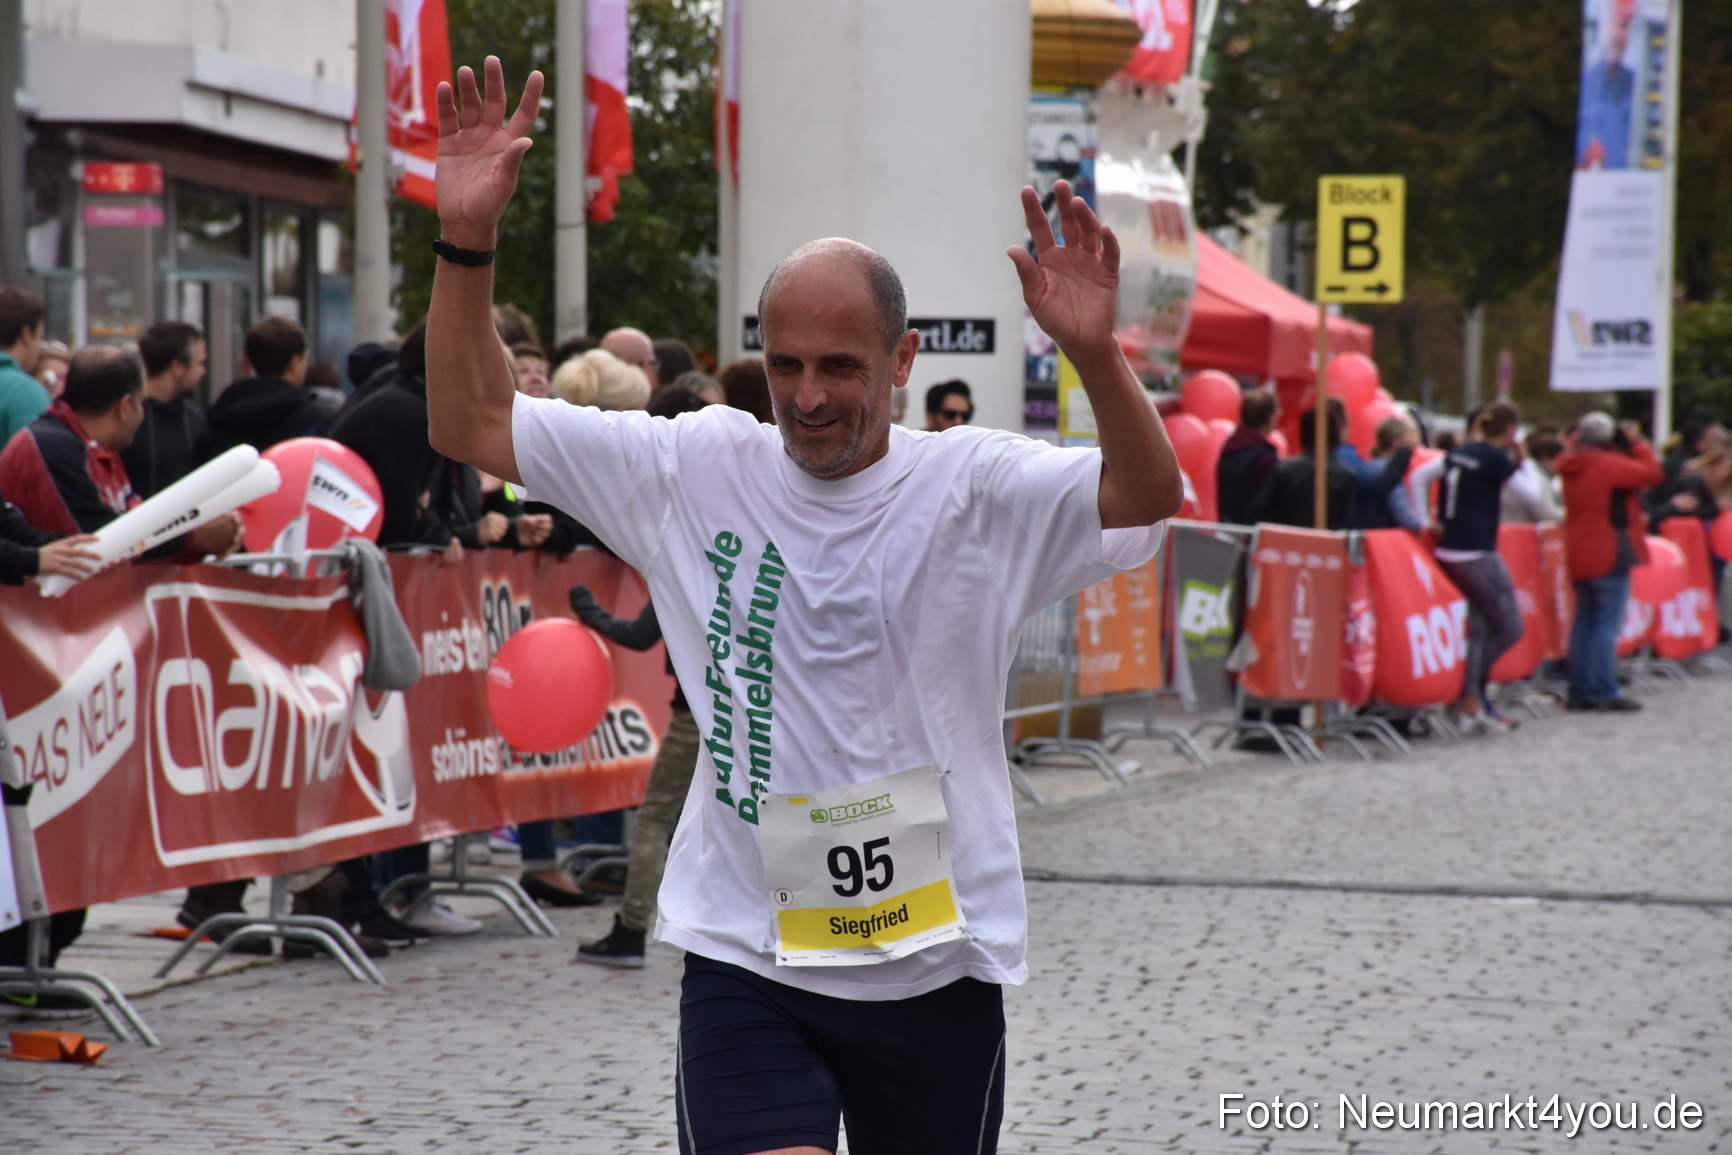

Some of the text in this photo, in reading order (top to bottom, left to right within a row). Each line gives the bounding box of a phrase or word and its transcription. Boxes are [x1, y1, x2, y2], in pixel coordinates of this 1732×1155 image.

[1329, 183, 1392, 205] Block
[1342, 217, 1380, 271] B
[78, 660, 127, 769] NEUE
[829, 793, 894, 822] BOCK
[827, 836, 894, 897] 95
[780, 892, 787, 902] D
[829, 903, 909, 939] Siegfried
